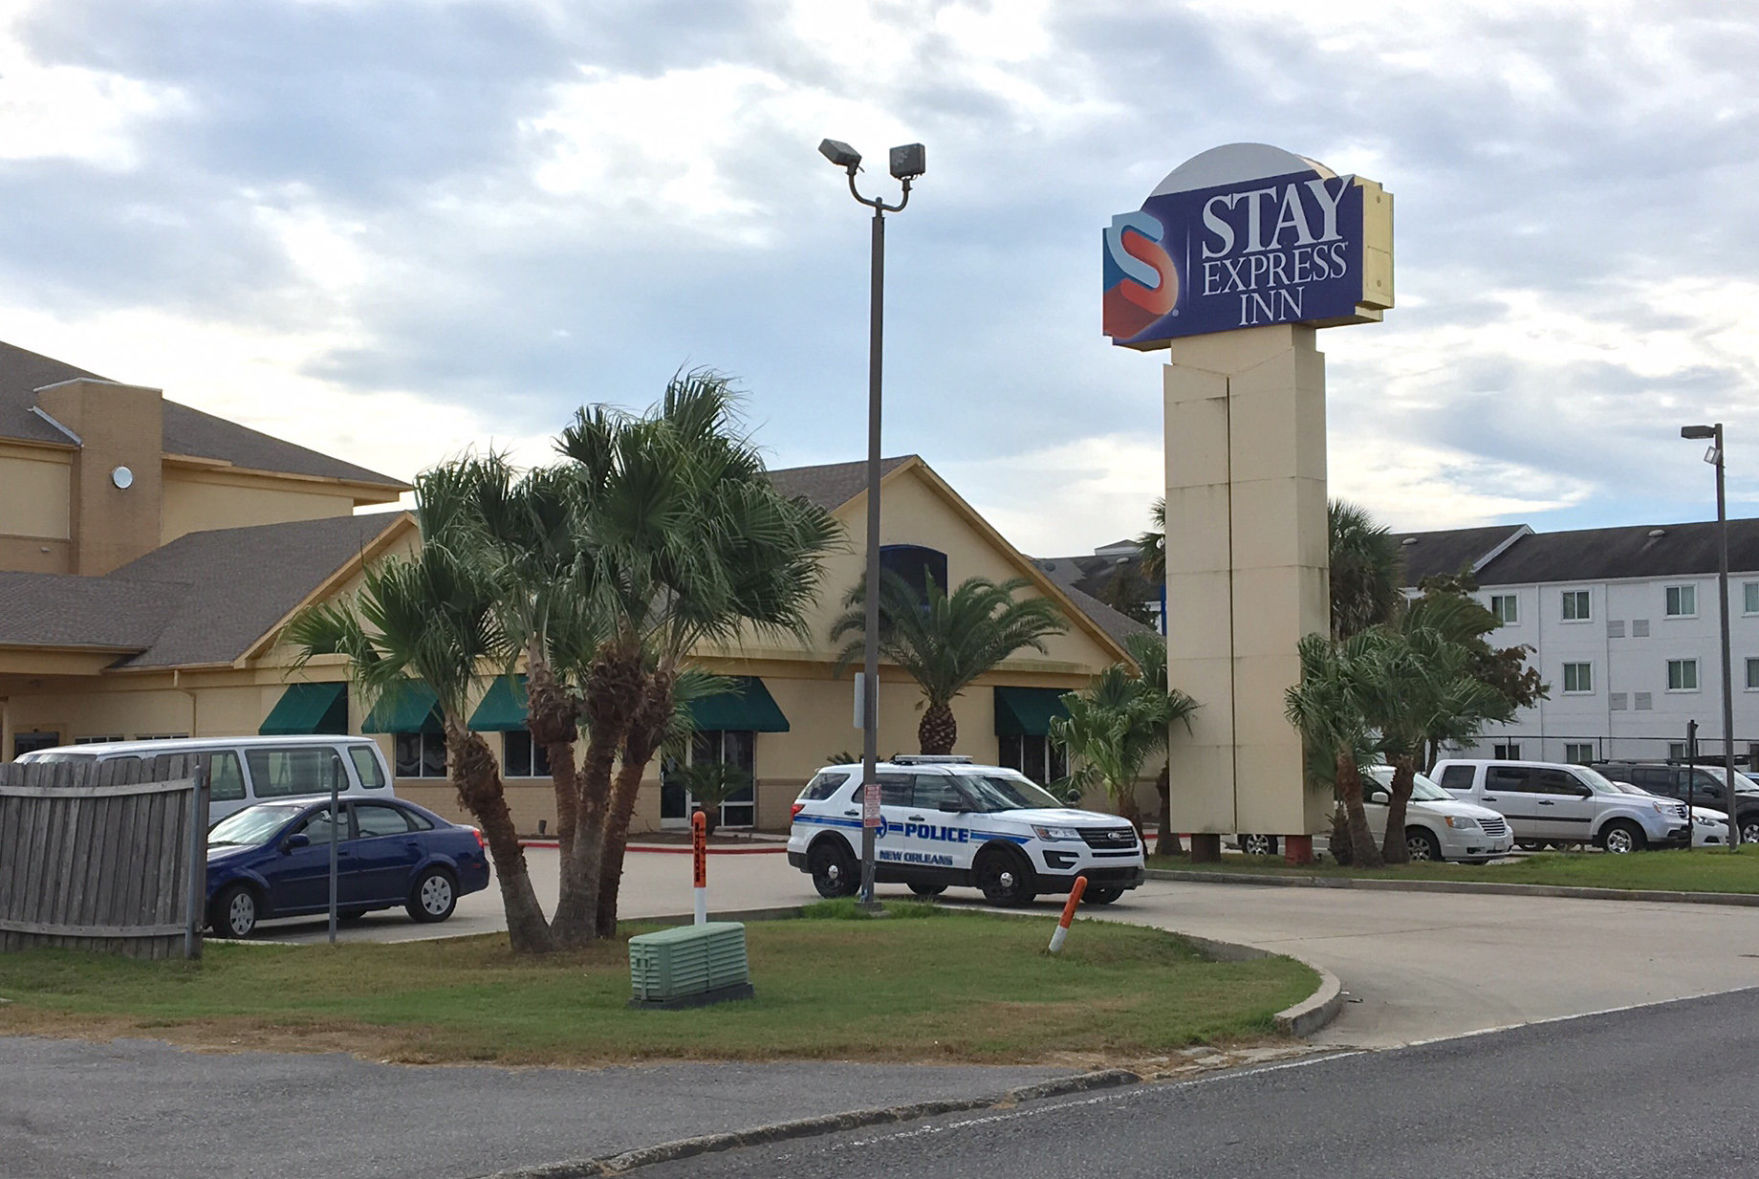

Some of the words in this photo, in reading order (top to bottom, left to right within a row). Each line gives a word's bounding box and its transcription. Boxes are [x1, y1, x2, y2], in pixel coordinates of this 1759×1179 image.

[1202, 175, 1351, 259] STAY
[1202, 241, 1349, 296] EXPRESS
[1238, 286, 1305, 326] INN
[905, 822, 969, 843] POLICE
[879, 849, 902, 861] NEW
[903, 851, 953, 866] ORLEANS
